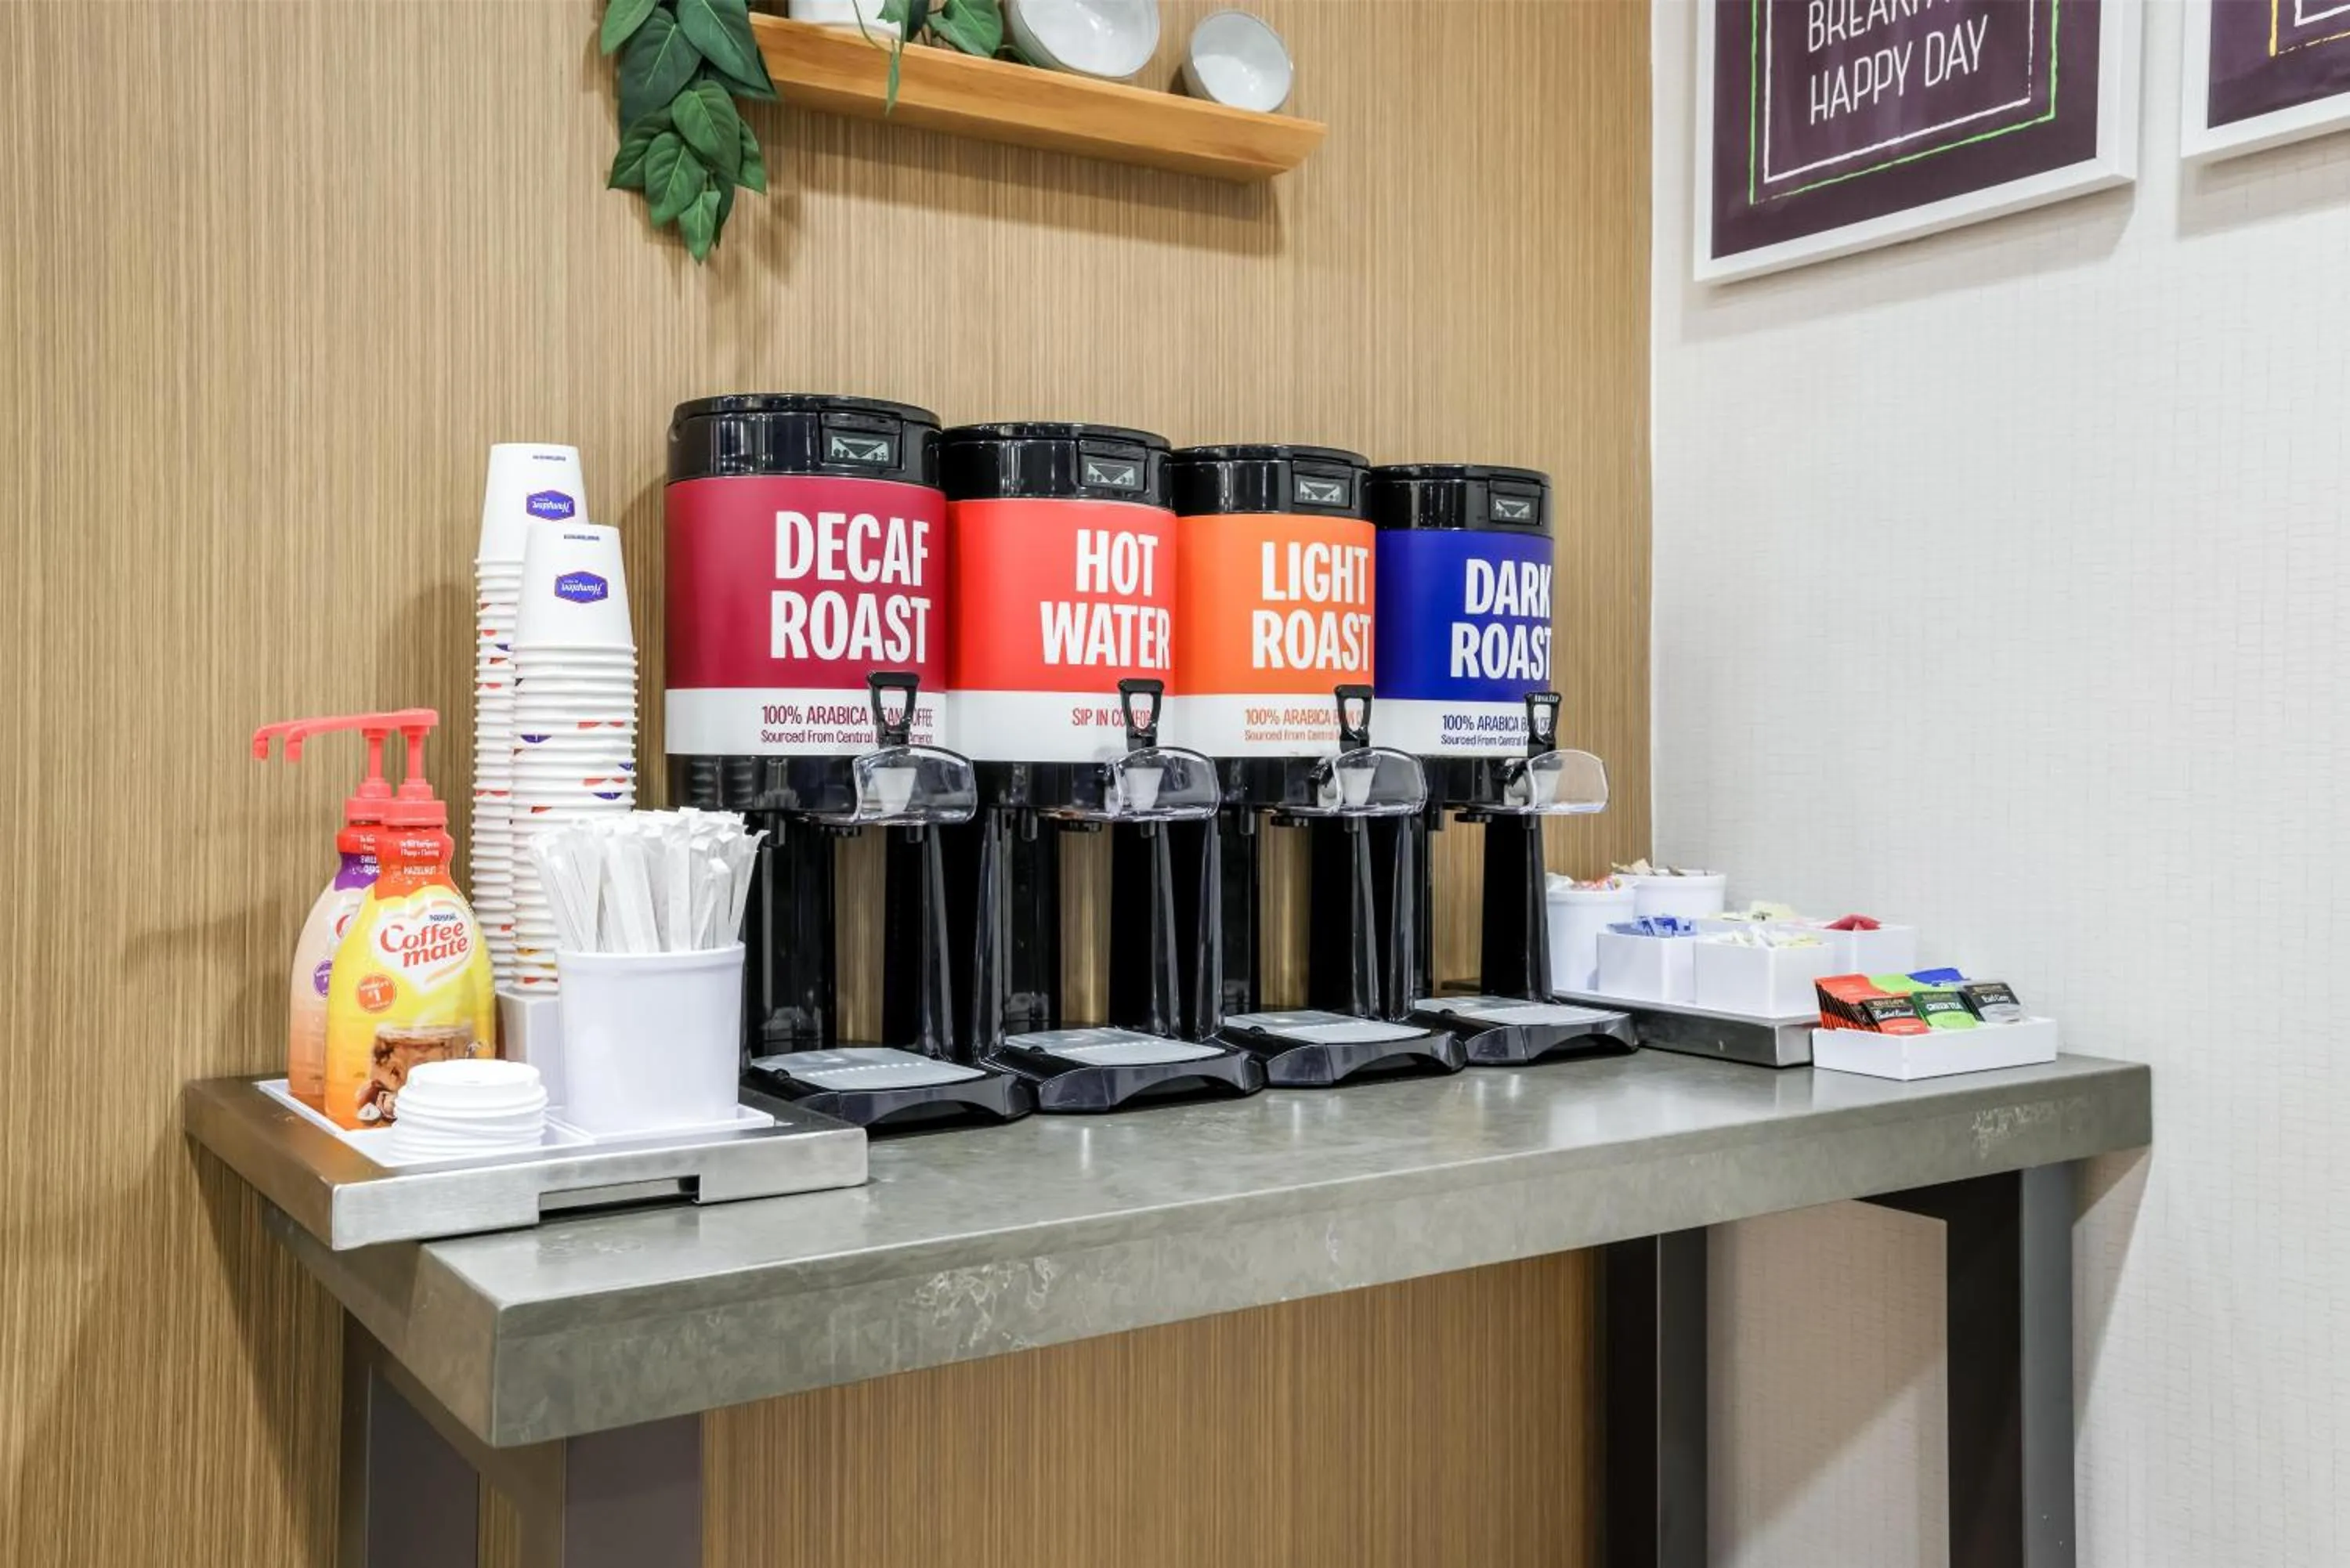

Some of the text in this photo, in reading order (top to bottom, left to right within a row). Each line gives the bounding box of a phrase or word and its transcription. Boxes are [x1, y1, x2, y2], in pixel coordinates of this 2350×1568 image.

[1810, 13, 1988, 125] HAPPY DAY
[775, 510, 930, 587] DECAF
[1076, 529, 1159, 598] HOT
[1262, 541, 1368, 605] LIGHT
[1464, 558, 1552, 619] DARK
[770, 590, 931, 663] ROAST
[1040, 601, 1170, 670] WATER
[1253, 609, 1372, 672] ROAST
[1450, 622, 1552, 681] ROAST
[761, 705, 802, 724] 100%
[806, 705, 869, 724] ARABICA
[761, 729, 805, 743] Sourced
[808, 729, 833, 743] From
[836, 729, 873, 743] Central
[1072, 708, 1093, 726] SIP
[1096, 708, 1108, 726] IN
[1245, 707, 1280, 725] 100%
[1283, 708, 1331, 725] ARABICA
[1442, 714, 1475, 731] 100%
[1477, 715, 1519, 731] ARABICA
[380, 921, 465, 953] Coffee
[403, 938, 468, 968] mate
